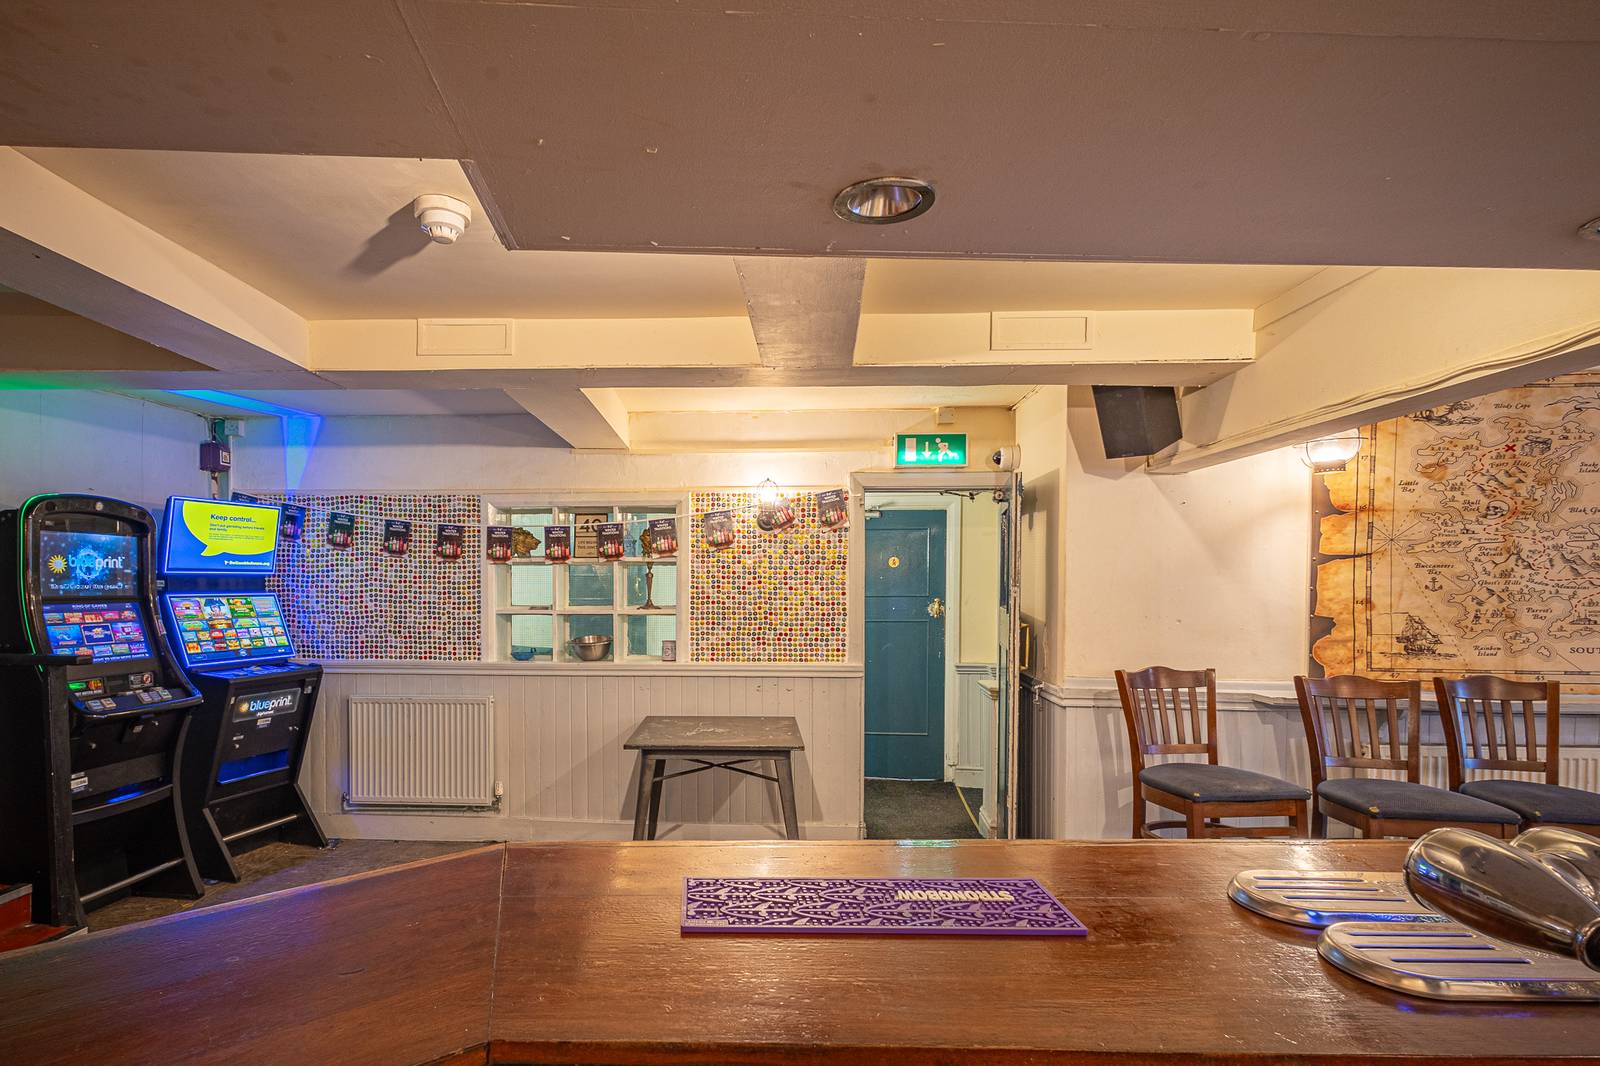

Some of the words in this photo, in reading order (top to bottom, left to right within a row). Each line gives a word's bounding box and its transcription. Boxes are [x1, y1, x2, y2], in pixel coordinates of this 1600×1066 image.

[210, 514, 228, 522] Keep
[250, 695, 292, 711] blueprint
[896, 889, 1015, 902] STRONGBOW
